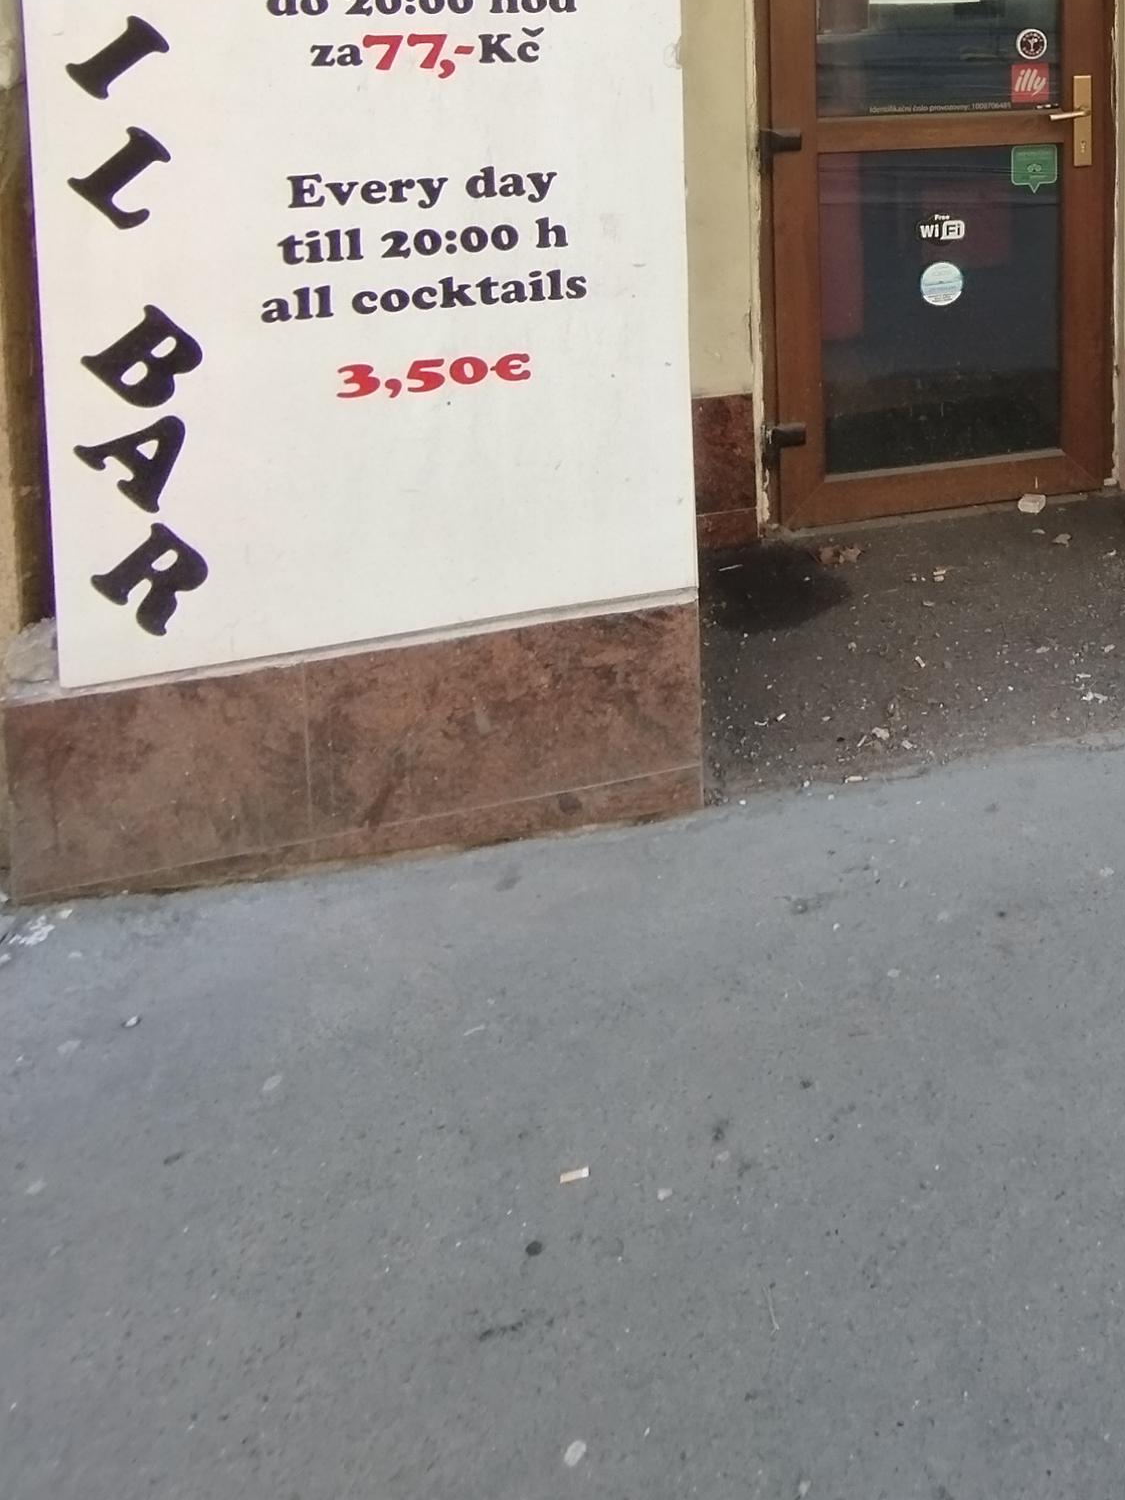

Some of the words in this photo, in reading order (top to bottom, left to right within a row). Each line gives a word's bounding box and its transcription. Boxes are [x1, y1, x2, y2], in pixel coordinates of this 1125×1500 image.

[1014, 68, 1047, 97] illy
[288, 174, 448, 209] Every
[465, 168, 557, 201] day
[278, 227, 363, 265] till
[380, 226, 519, 259] 20:00
[536, 217, 568, 250] h
[260, 286, 334, 323] all
[351, 269, 588, 315] cocktails
[336, 351, 532, 398] 3,50€
[73, 304, 209, 636] BAR
